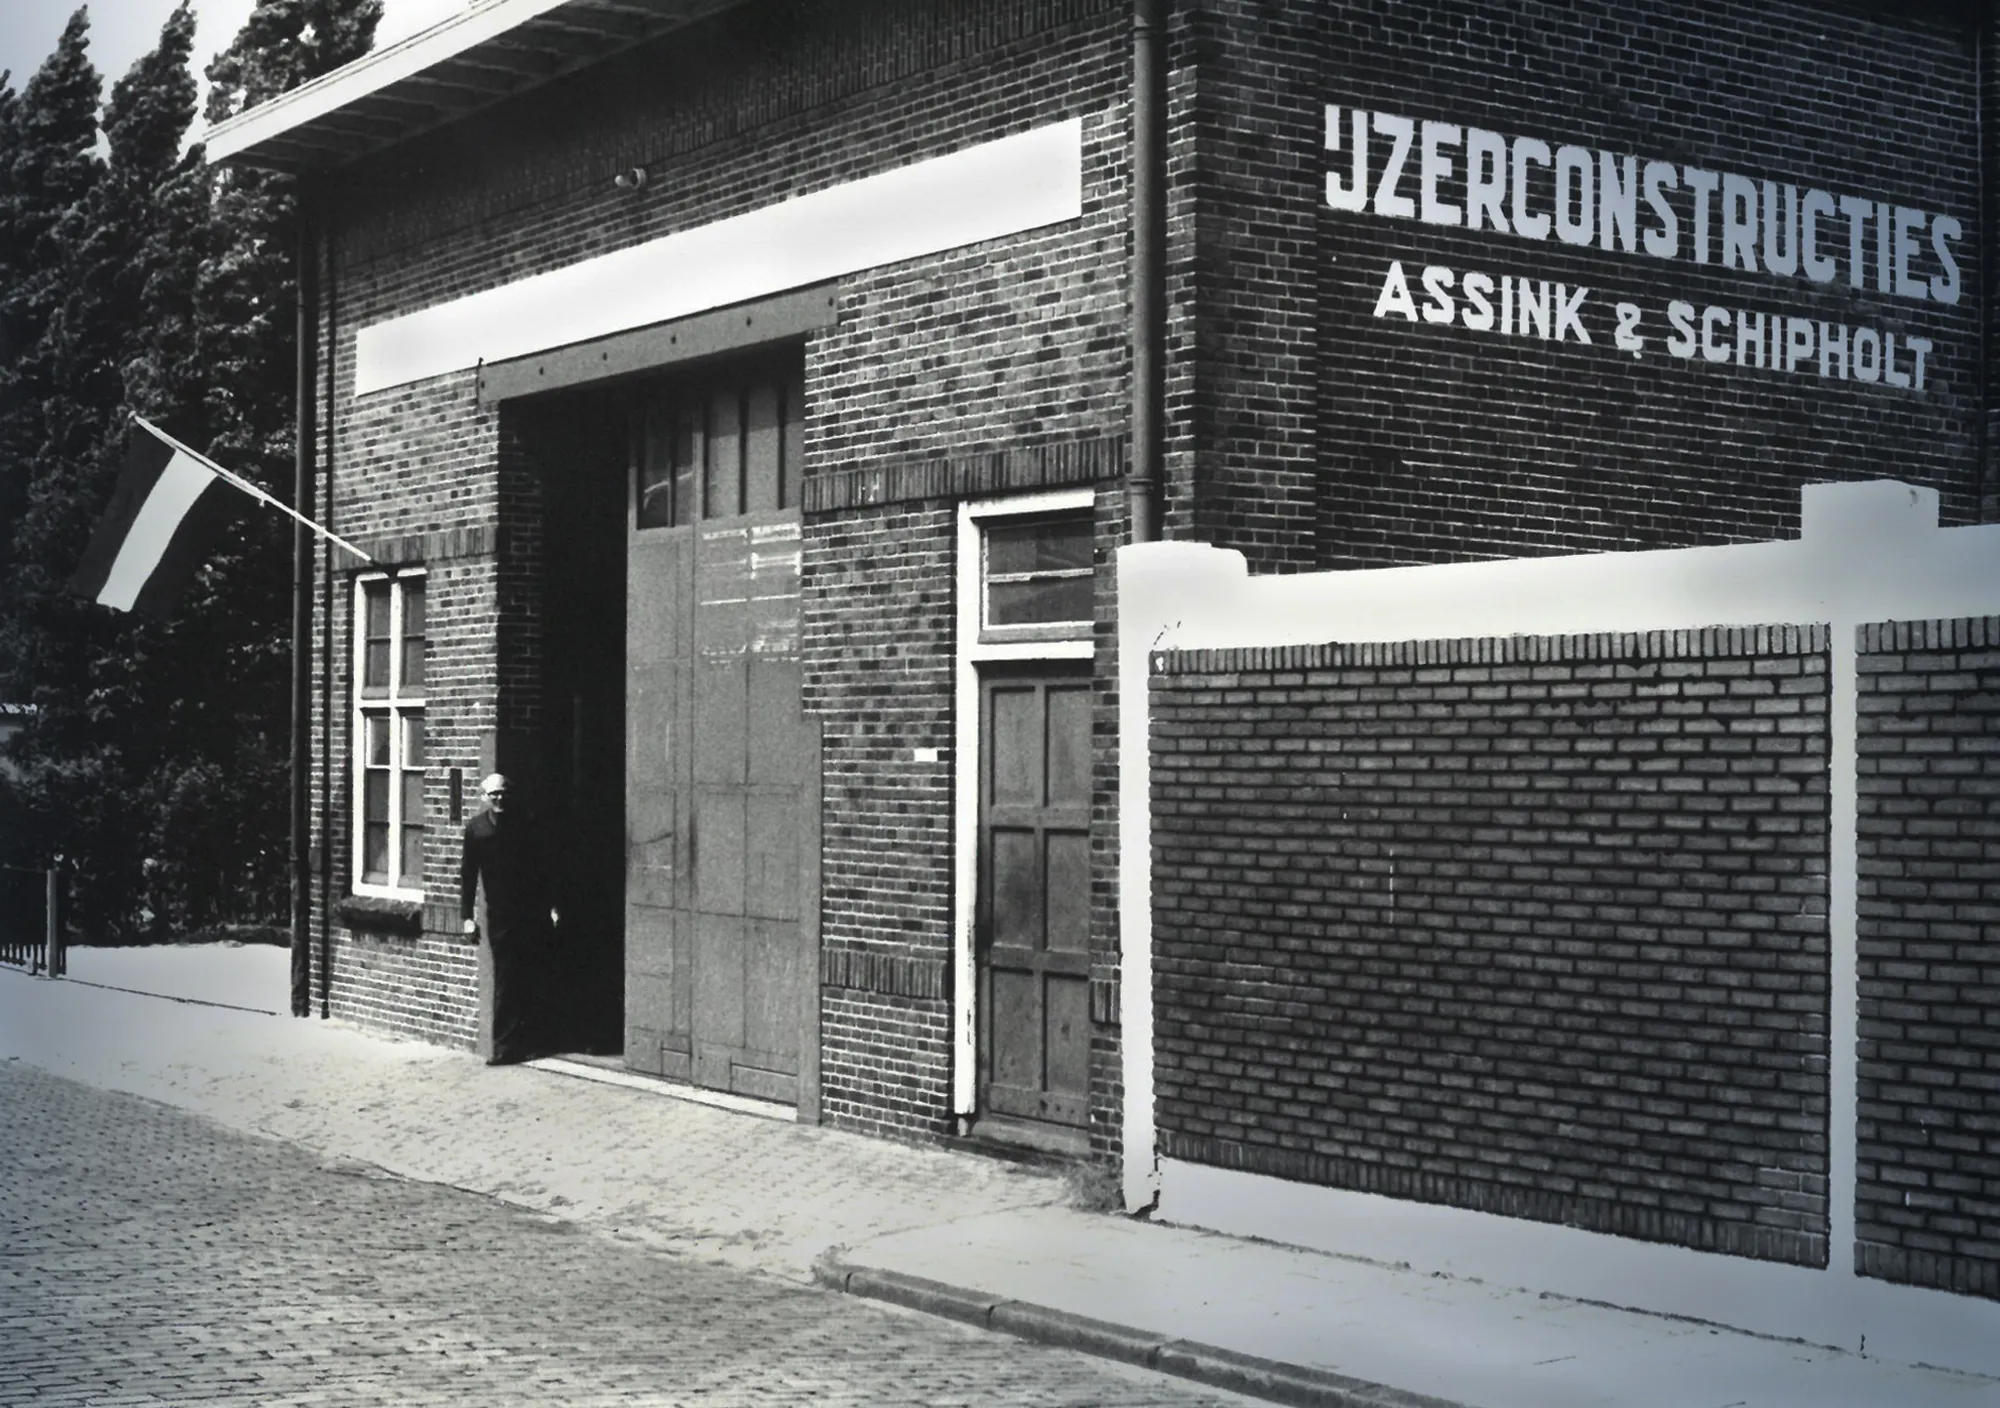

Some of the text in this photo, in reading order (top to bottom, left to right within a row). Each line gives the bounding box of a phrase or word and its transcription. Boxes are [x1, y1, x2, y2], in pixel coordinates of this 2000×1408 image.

[1325, 104, 1962, 304] IJZERCONSTRUCTIES
[1373, 260, 1933, 390] ASSINK & SCHIPHOLT
